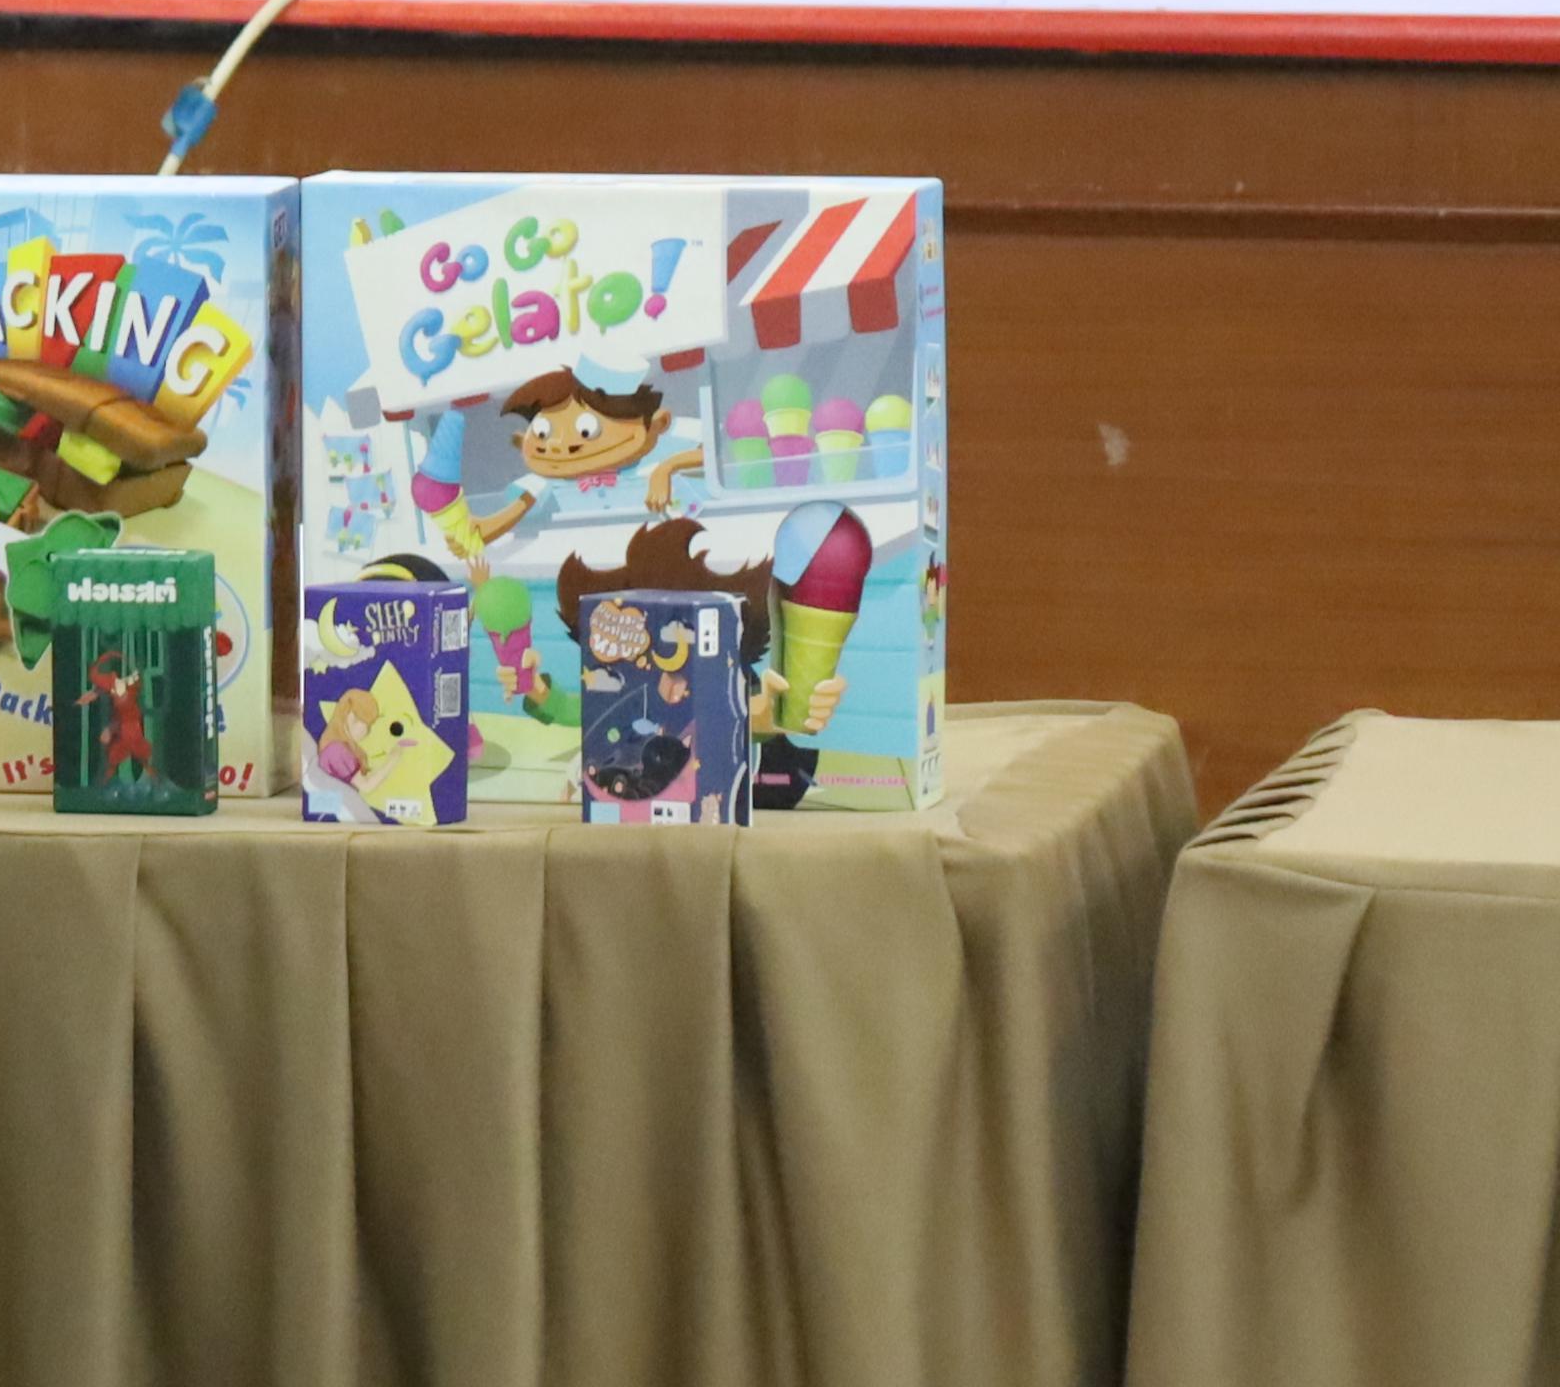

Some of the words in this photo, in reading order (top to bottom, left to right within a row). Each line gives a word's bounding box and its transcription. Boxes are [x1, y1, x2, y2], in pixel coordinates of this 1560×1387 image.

[398, 237, 688, 387] Gelato!
[68, 576, 177, 604] ฟอเรสต์
[365, 600, 416, 631] SLEEP
[218, 762, 255, 792] o!
